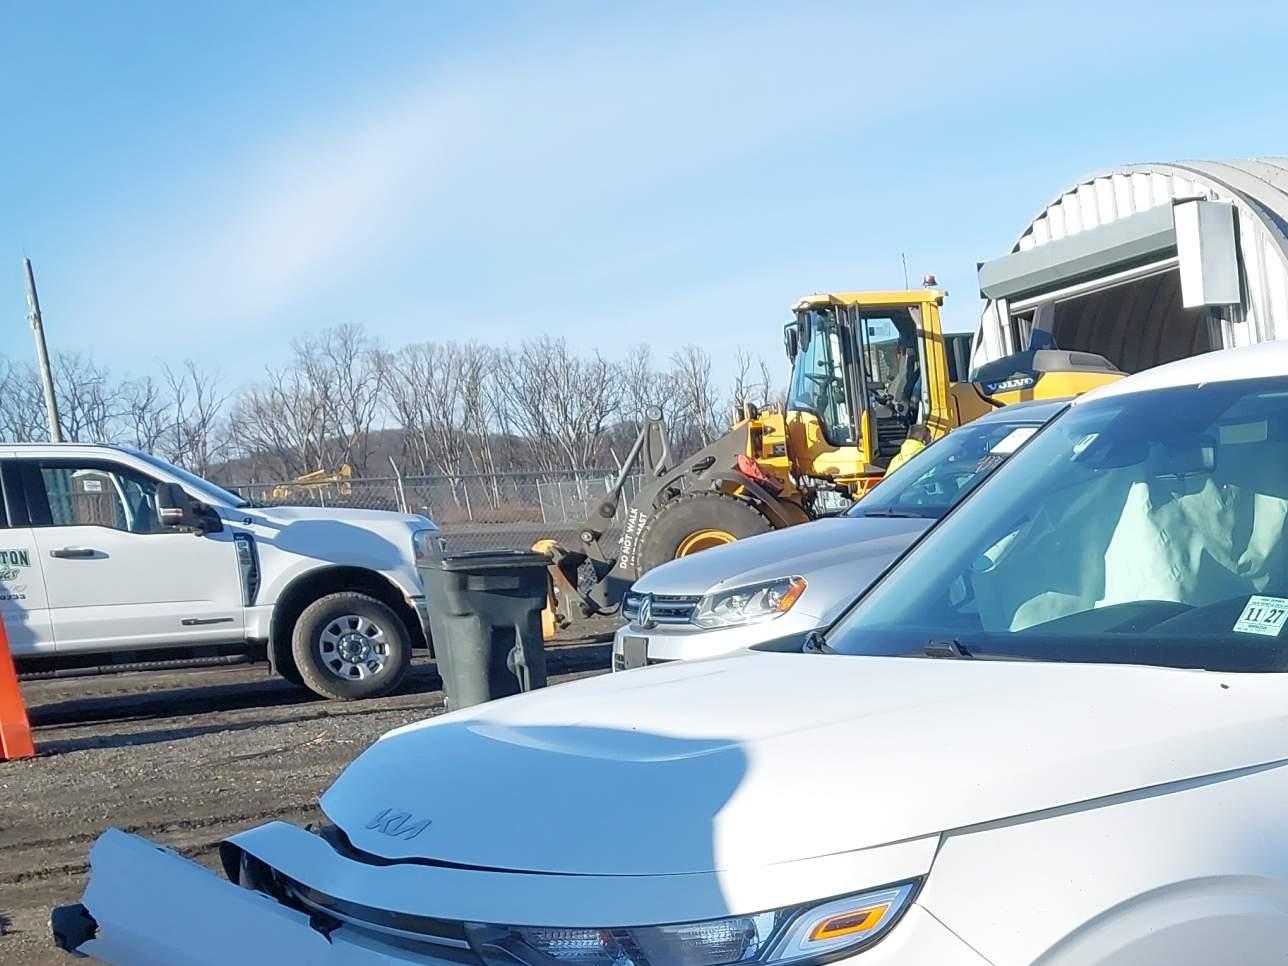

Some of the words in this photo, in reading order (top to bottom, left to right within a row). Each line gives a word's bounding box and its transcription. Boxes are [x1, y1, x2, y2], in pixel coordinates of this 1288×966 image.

[986, 377, 1034, 391] VOLVO
[626, 507, 639, 533] WALK
[622, 534, 633, 554] NOT
[619, 555, 629, 569] DO
[1244, 607, 1263, 621] 11
[1264, 609, 1286, 623] 27
